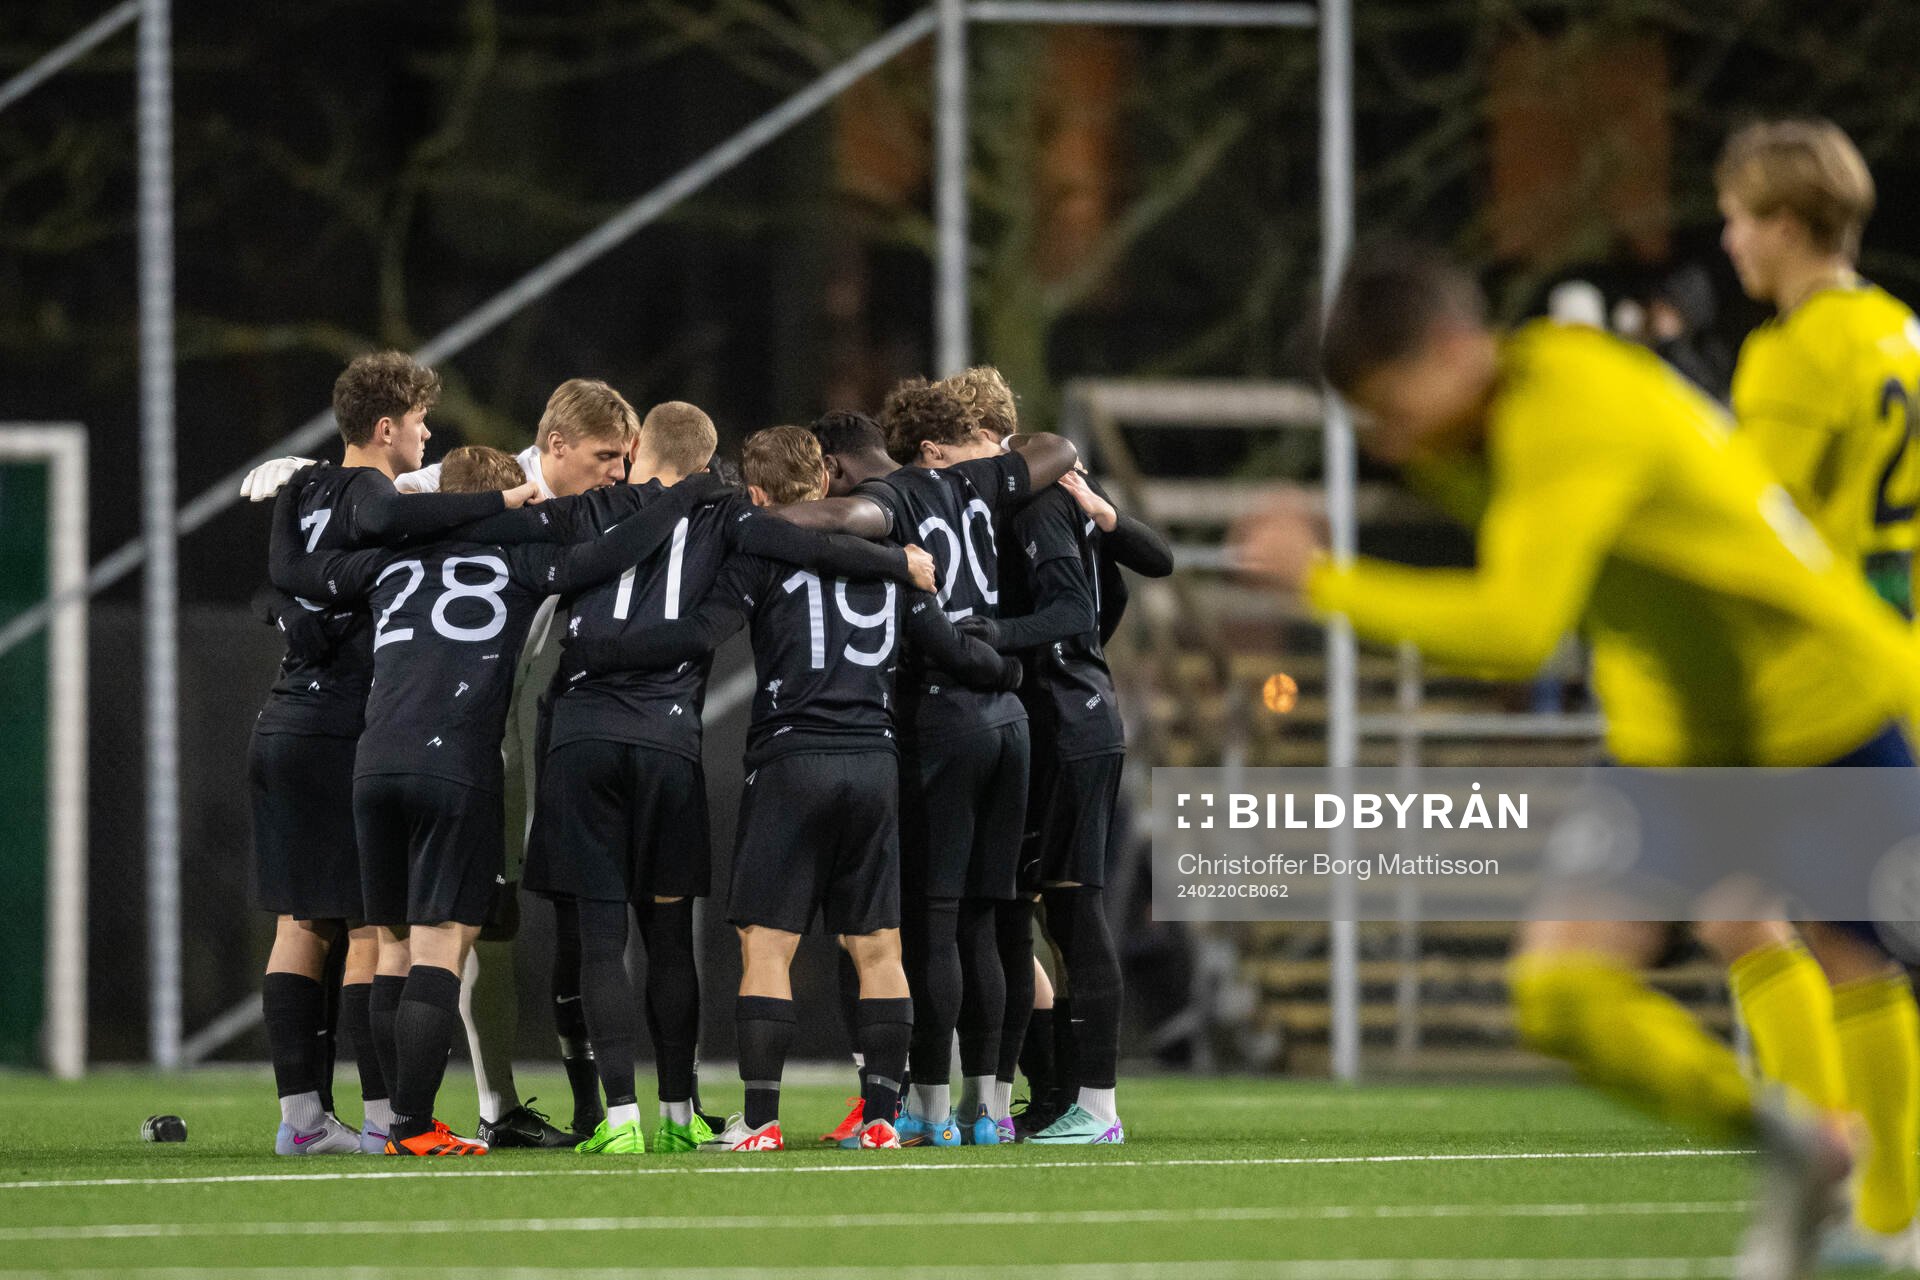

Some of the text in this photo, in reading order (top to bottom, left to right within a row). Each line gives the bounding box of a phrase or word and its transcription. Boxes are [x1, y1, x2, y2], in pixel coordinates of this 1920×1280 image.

[374, 555, 509, 653] 28
[919, 499, 998, 623] 20
[782, 570, 896, 669] 19
